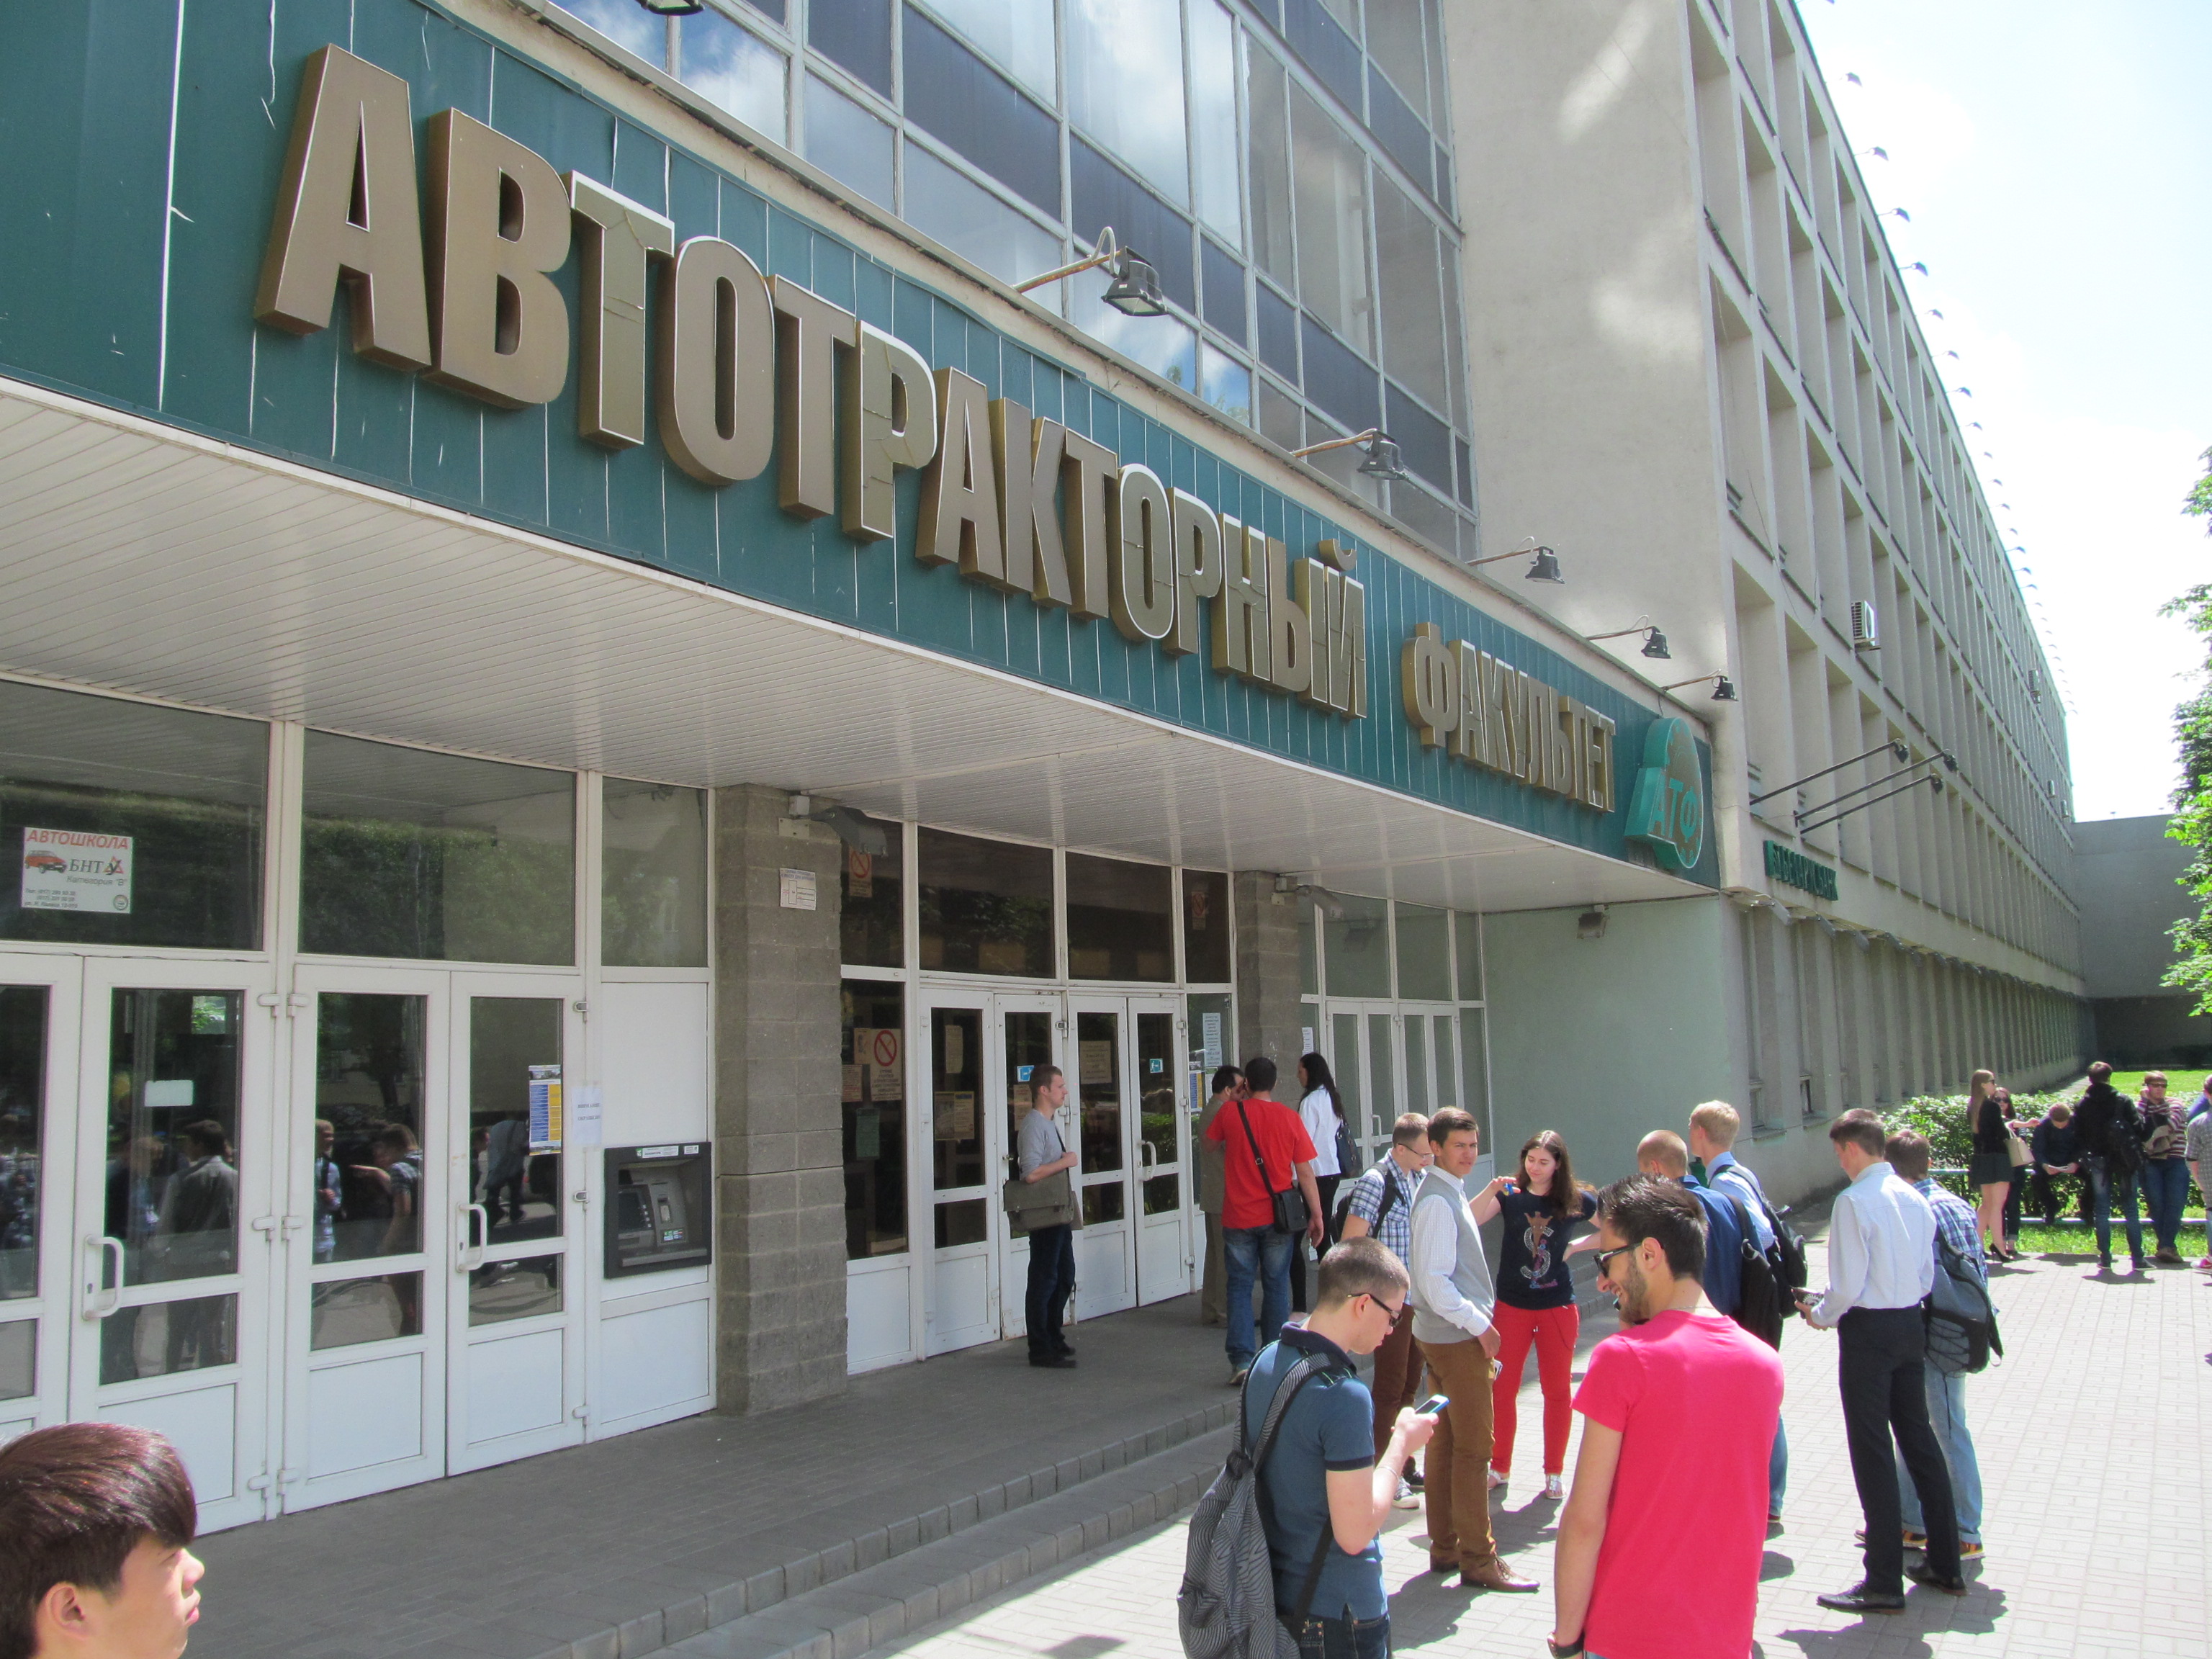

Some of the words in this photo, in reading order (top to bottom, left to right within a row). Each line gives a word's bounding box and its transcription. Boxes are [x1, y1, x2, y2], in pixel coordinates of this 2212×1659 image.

[254, 43, 1367, 719] АВТОТРАКТОРНЫЙ
[1401, 622, 1616, 812] ФАКУЛЬТЕТ
[26, 830, 128, 850] АВТОШКОЛА
[1647, 767, 1699, 843] АТФ
